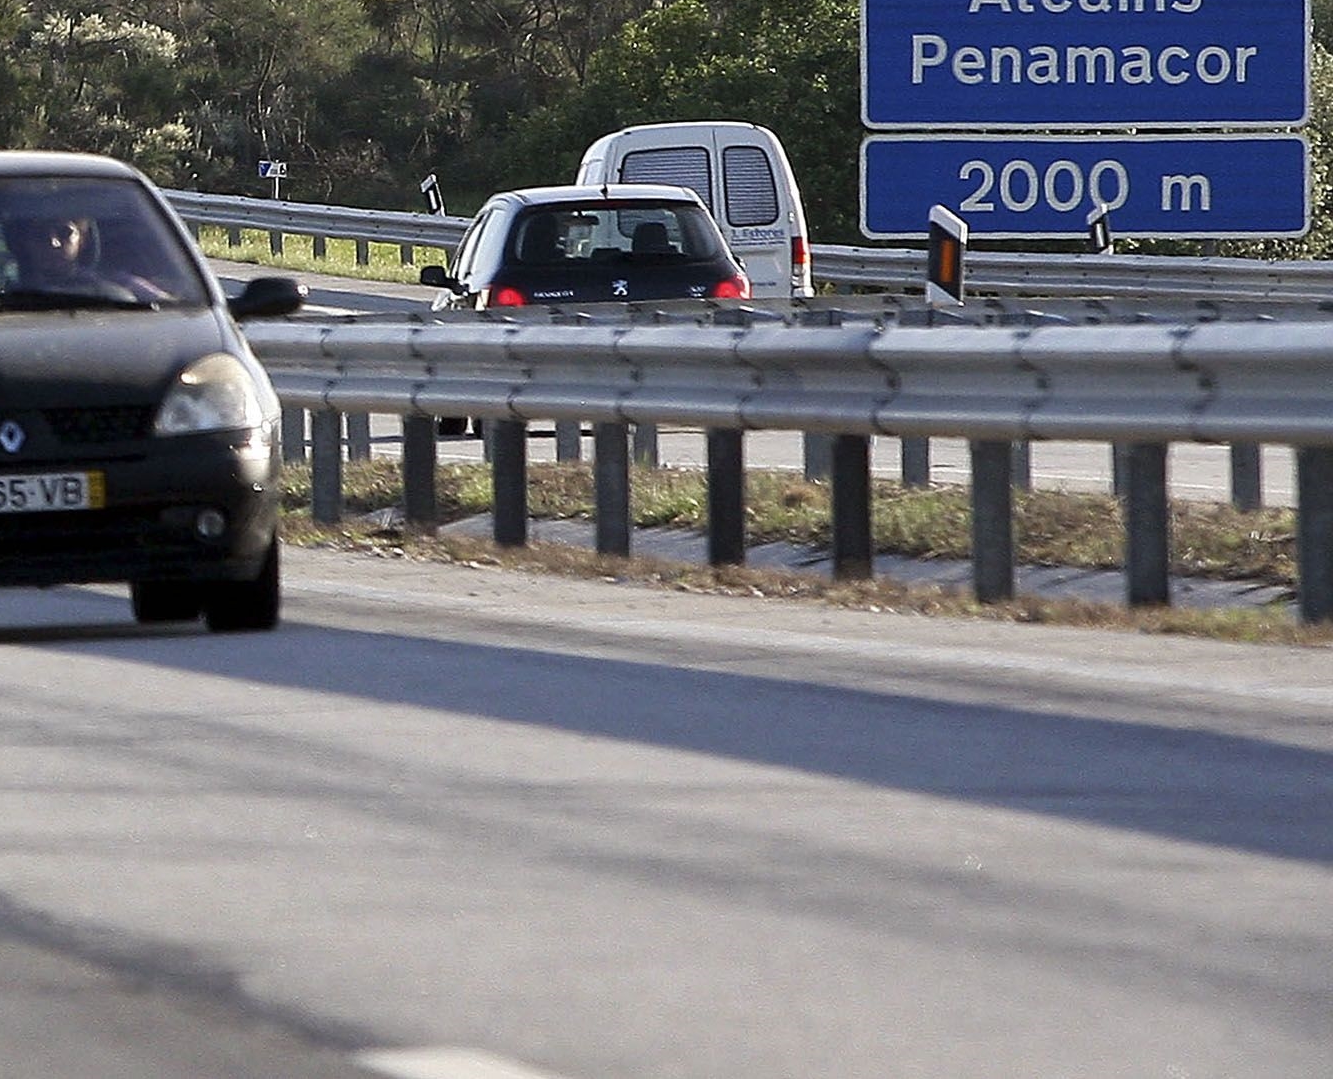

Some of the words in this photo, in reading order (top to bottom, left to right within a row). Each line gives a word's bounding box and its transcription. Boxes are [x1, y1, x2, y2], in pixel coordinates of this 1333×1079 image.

[911, 33, 1257, 84] Penamacor
[959, 160, 1129, 212] 2000
[1161, 174, 1211, 211] m
